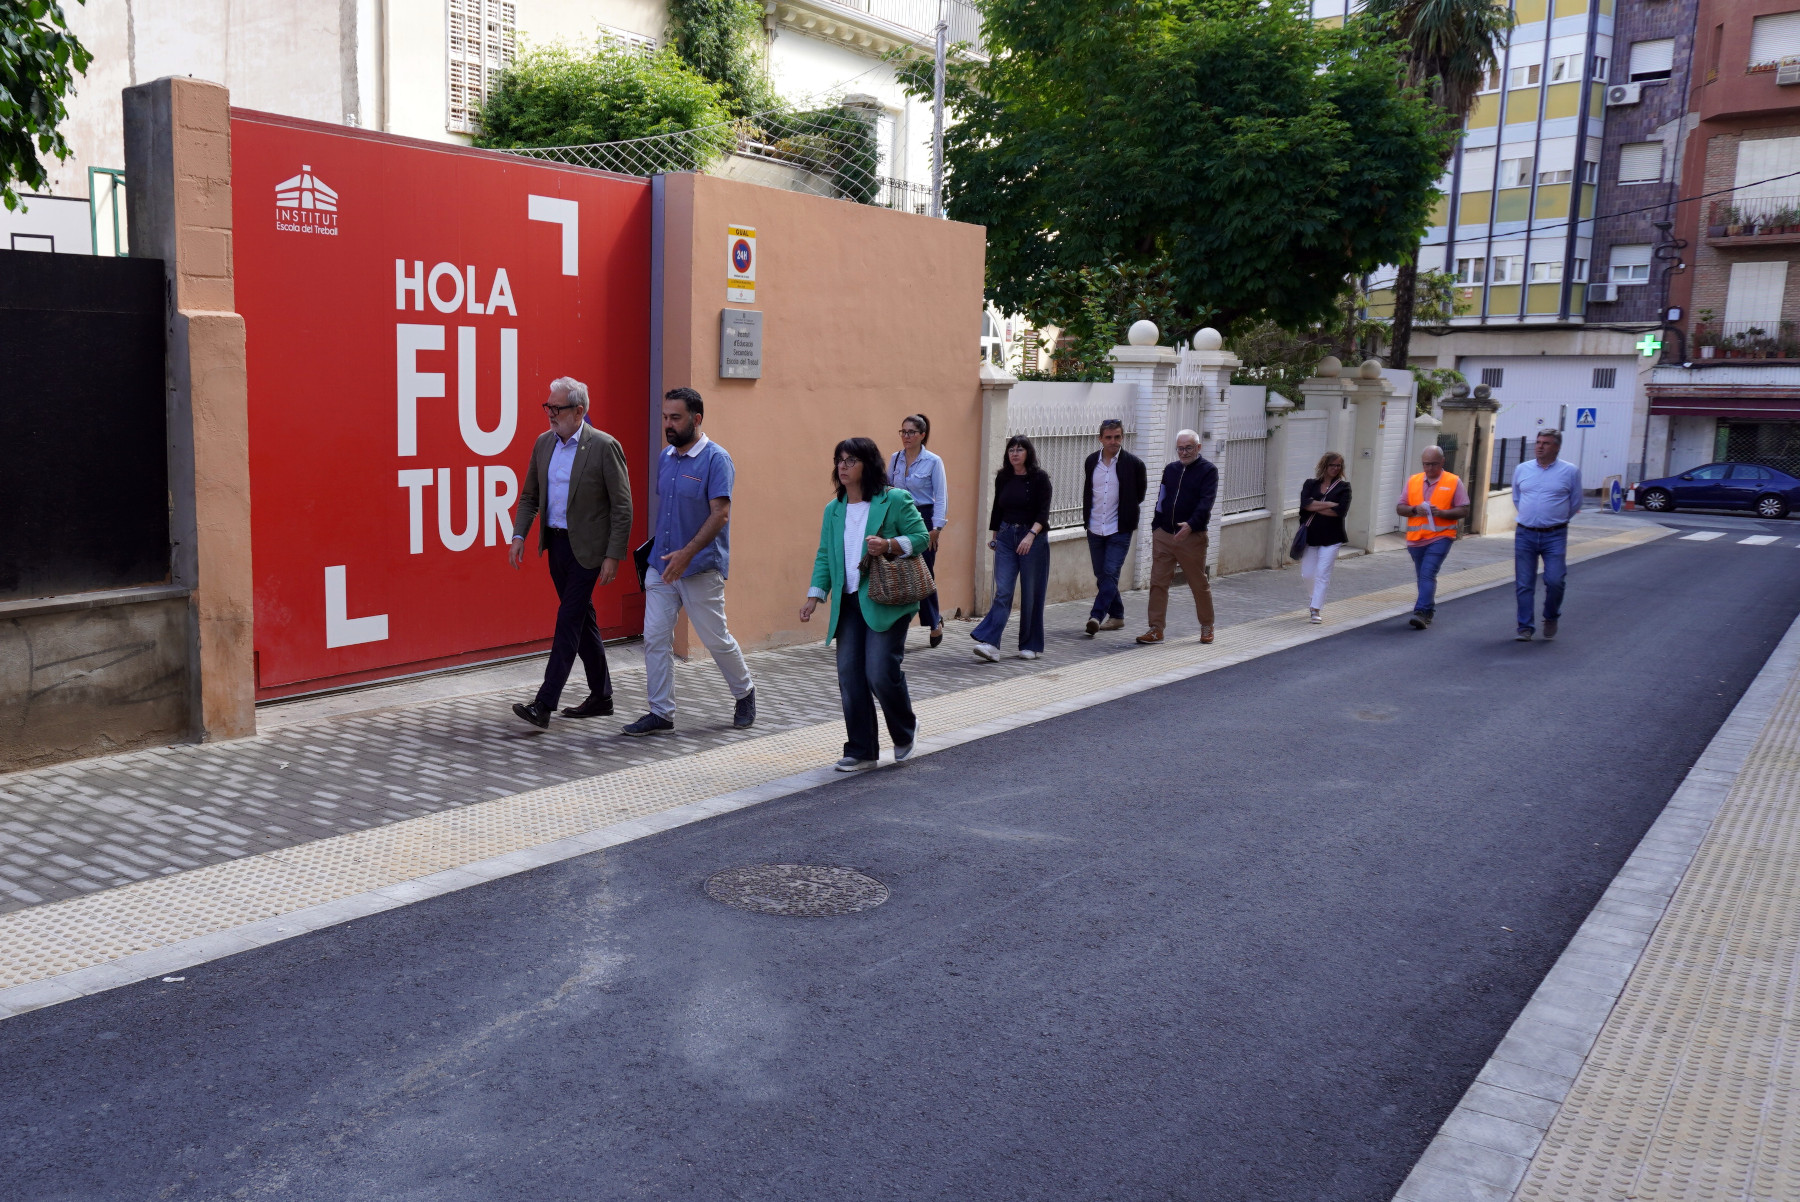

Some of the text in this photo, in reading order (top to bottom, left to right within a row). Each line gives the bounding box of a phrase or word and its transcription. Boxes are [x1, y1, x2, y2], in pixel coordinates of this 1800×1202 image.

[276, 209, 338, 226] INSTITUT
[276, 221, 338, 236] Escola del Treball
[735, 229, 749, 237] GUAL
[736, 250, 748, 261] 24H
[395, 258, 518, 316] HOLA
[396, 323, 519, 457] FU
[397, 465, 519, 555] TUR
